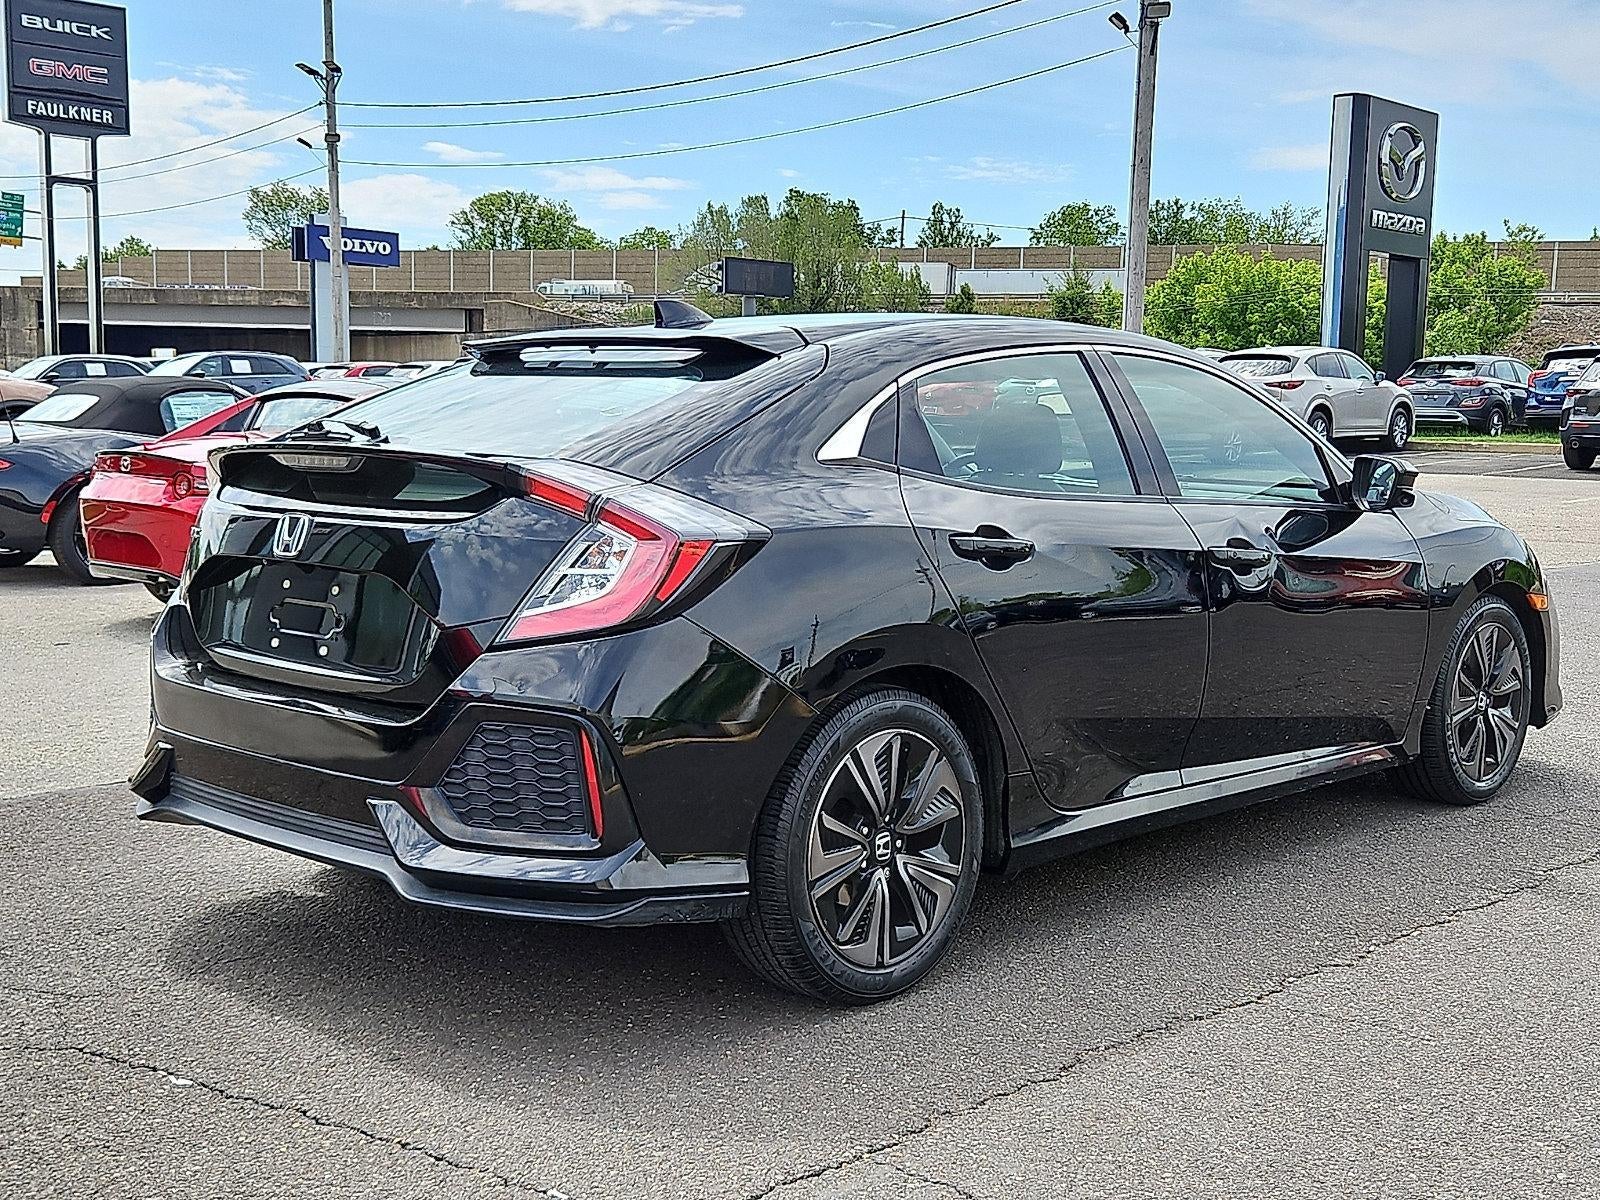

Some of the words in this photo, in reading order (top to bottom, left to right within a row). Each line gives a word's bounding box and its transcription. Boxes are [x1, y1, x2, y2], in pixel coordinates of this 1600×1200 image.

[21, 14, 113, 40] BUICK
[29, 58, 109, 84] GMC
[27, 100, 114, 124] FAULKNER
